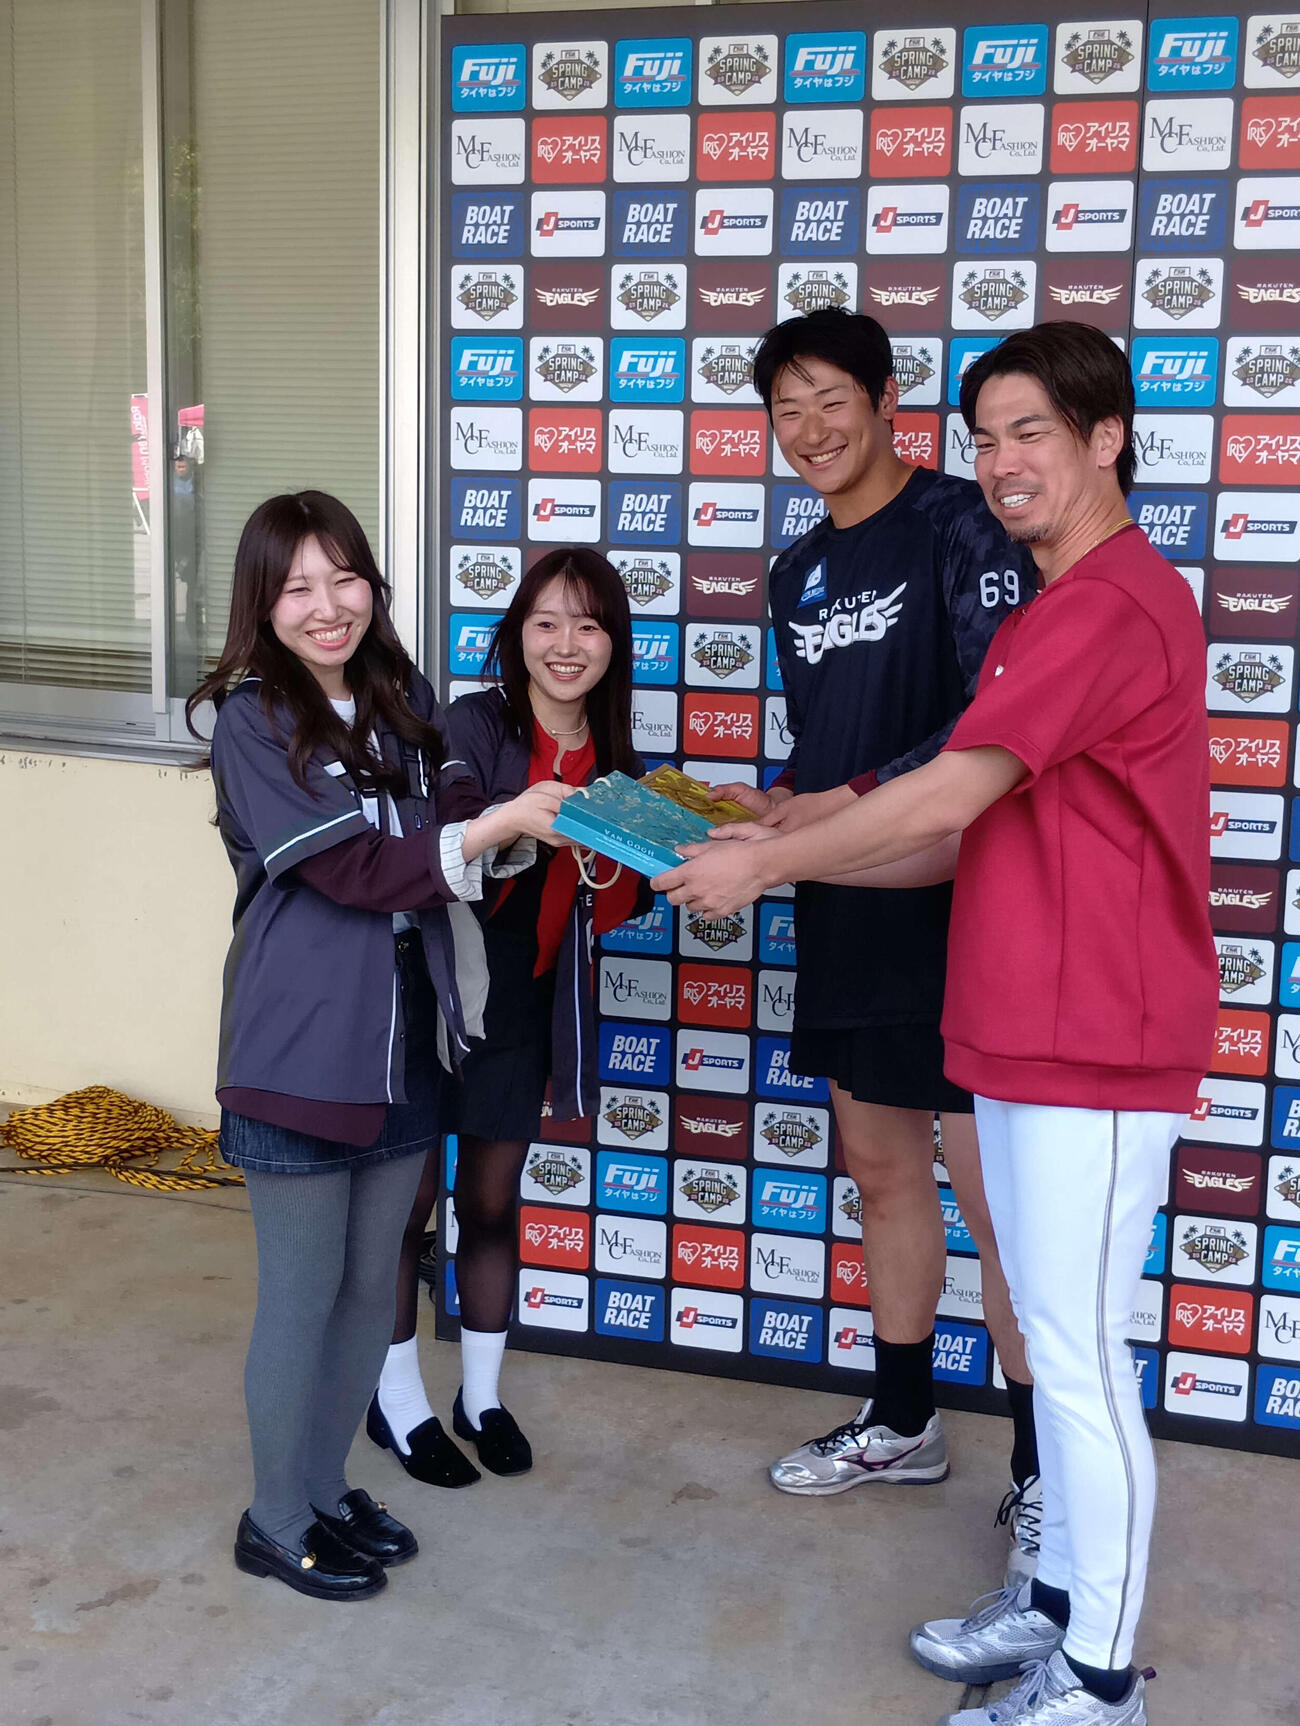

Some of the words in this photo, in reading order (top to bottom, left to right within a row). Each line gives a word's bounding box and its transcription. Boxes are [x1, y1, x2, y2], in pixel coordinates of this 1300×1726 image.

[972, 39, 1038, 68] Fuji
[1078, 43, 1118, 60] SPRING
[1159, 32, 1228, 62] Fuji
[719, 57, 756, 73] SPRING
[794, 46, 856, 75] Fuji
[894, 50, 933, 66] SPRING
[1084, 58, 1112, 73] CAMP
[460, 58, 517, 85] Fuji
[552, 62, 587, 78] SPRING
[624, 52, 683, 80] Fuji
[900, 65, 927, 79] CAMP
[1158, 63, 1225, 76] タイヤはフジ
[558, 76, 583, 90] CAMP
[725, 71, 751, 85] CAMP
[794, 76, 854, 89] タイヤはフジ
[972, 69, 1036, 82] タイヤはフジ
[461, 86, 516, 98] タイヤはフジ
[624, 81, 682, 94] タイヤはフジ
[903, 127, 945, 143] アイリス
[1086, 121, 1130, 138] アイリス
[562, 135, 600, 150] アイリス
[729, 131, 769, 147] アイリス
[1085, 137, 1130, 152] オーヤマ
[562, 150, 600, 164] オーヤマ
[728, 147, 769, 161] オーヤマ
[902, 142, 945, 157] オーヤマ
[795, 201, 849, 221] BOAT
[972, 197, 1028, 218] BOAT
[1156, 193, 1216, 215] BOAT
[465, 205, 514, 225] BOAT
[627, 203, 678, 223] BOAT
[896, 216, 936, 224] SPORTS
[1077, 213, 1119, 221] SPORTS
[558, 220, 594, 228] SPORTS
[790, 221, 844, 241] RACE
[966, 218, 1023, 239] RACE
[1150, 215, 1210, 236] RACE
[461, 225, 510, 244] RACE
[622, 223, 673, 243] RACE
[470, 285, 504, 298] SPRING
[974, 282, 1013, 297] SPRING
[1158, 280, 1199, 295] SPRING
[1244, 287, 1300, 303] EAGLES
[476, 298, 500, 310] CAMP
[542, 292, 593, 306] EAGLES
[706, 291, 759, 306] EAGLES
[877, 290, 933, 305] EAGLES
[980, 297, 1008, 310] CAMP
[1056, 289, 1115, 304] EAGLES
[1164, 295, 1193, 308] CAMP
[459, 350, 515, 375] Fuji
[549, 357, 583, 371] SPRING
[618, 351, 677, 377] Fuji
[1141, 351, 1208, 379] Fuji
[1249, 359, 1291, 374] SPRING
[459, 377, 513, 387] タイヤはフジ
[554, 371, 579, 383] CAMP
[618, 379, 675, 389] タイヤはフジ
[1255, 373, 1285, 387] CAMP
[1140, 381, 1205, 392] タイヤはフジ
[721, 429, 760, 443] アイリス
[720, 443, 760, 457] オーヤマ
[464, 489, 512, 508] BOAT
[621, 494, 671, 513] BOAT
[460, 508, 508, 527] RACE
[617, 513, 667, 532] RACE
[715, 511, 753, 519] SPORTS
[1138, 505, 1196, 525] BOAT
[1246, 523, 1290, 531] SPORTS
[469, 565, 502, 579] SPRING
[474, 578, 497, 590] CAMP
[699, 580, 751, 595] EAGLES
[980, 570, 1020, 608] 69
[1224, 597, 1285, 613] EAGLES
[705, 644, 740, 658] SPRING
[710, 657, 735, 669] CAMP
[1229, 665, 1269, 680] SPRING
[1235, 679, 1263, 692] CAMP
[714, 711, 752, 726] アイリス
[713, 725, 752, 740] オーヤマ
[604, 829, 623, 841] VAN
[612, 1035, 660, 1055] BOAT
[608, 1052, 656, 1073] RACE
[703, 1057, 739, 1067] SPORTS
[616, 1107, 649, 1121] SPRING
[622, 1119, 645, 1131] CAMP
[687, 1120, 737, 1138] EAGLES
[539, 1163, 571, 1177] SPRING
[604, 1164, 659, 1191] Fuji
[545, 1174, 567, 1187] CAMP
[693, 1180, 726, 1195] SPRING
[1190, 1173, 1248, 1193] EAGLES
[605, 1188, 658, 1203] タイヤはフジ
[698, 1192, 722, 1205] CAMP
[761, 1181, 818, 1209] Fuji
[761, 1206, 816, 1221] タイヤはフジ
[701, 1243, 738, 1259] アイリス
[1195, 1237, 1234, 1254] SPRING
[701, 1255, 738, 1272] オーヤマ
[1201, 1250, 1228, 1264] CAMP
[544, 1296, 578, 1306] SPORTS
[608, 1291, 655, 1312] BOAT
[604, 1308, 651, 1329] RACE
[1203, 1305, 1245, 1322] アイリス
[763, 1311, 812, 1332] BOAT
[1202, 1318, 1244, 1335] オーヤマ
[759, 1328, 808, 1350] RACE
[1195, 1382, 1235, 1393] SPORTS
